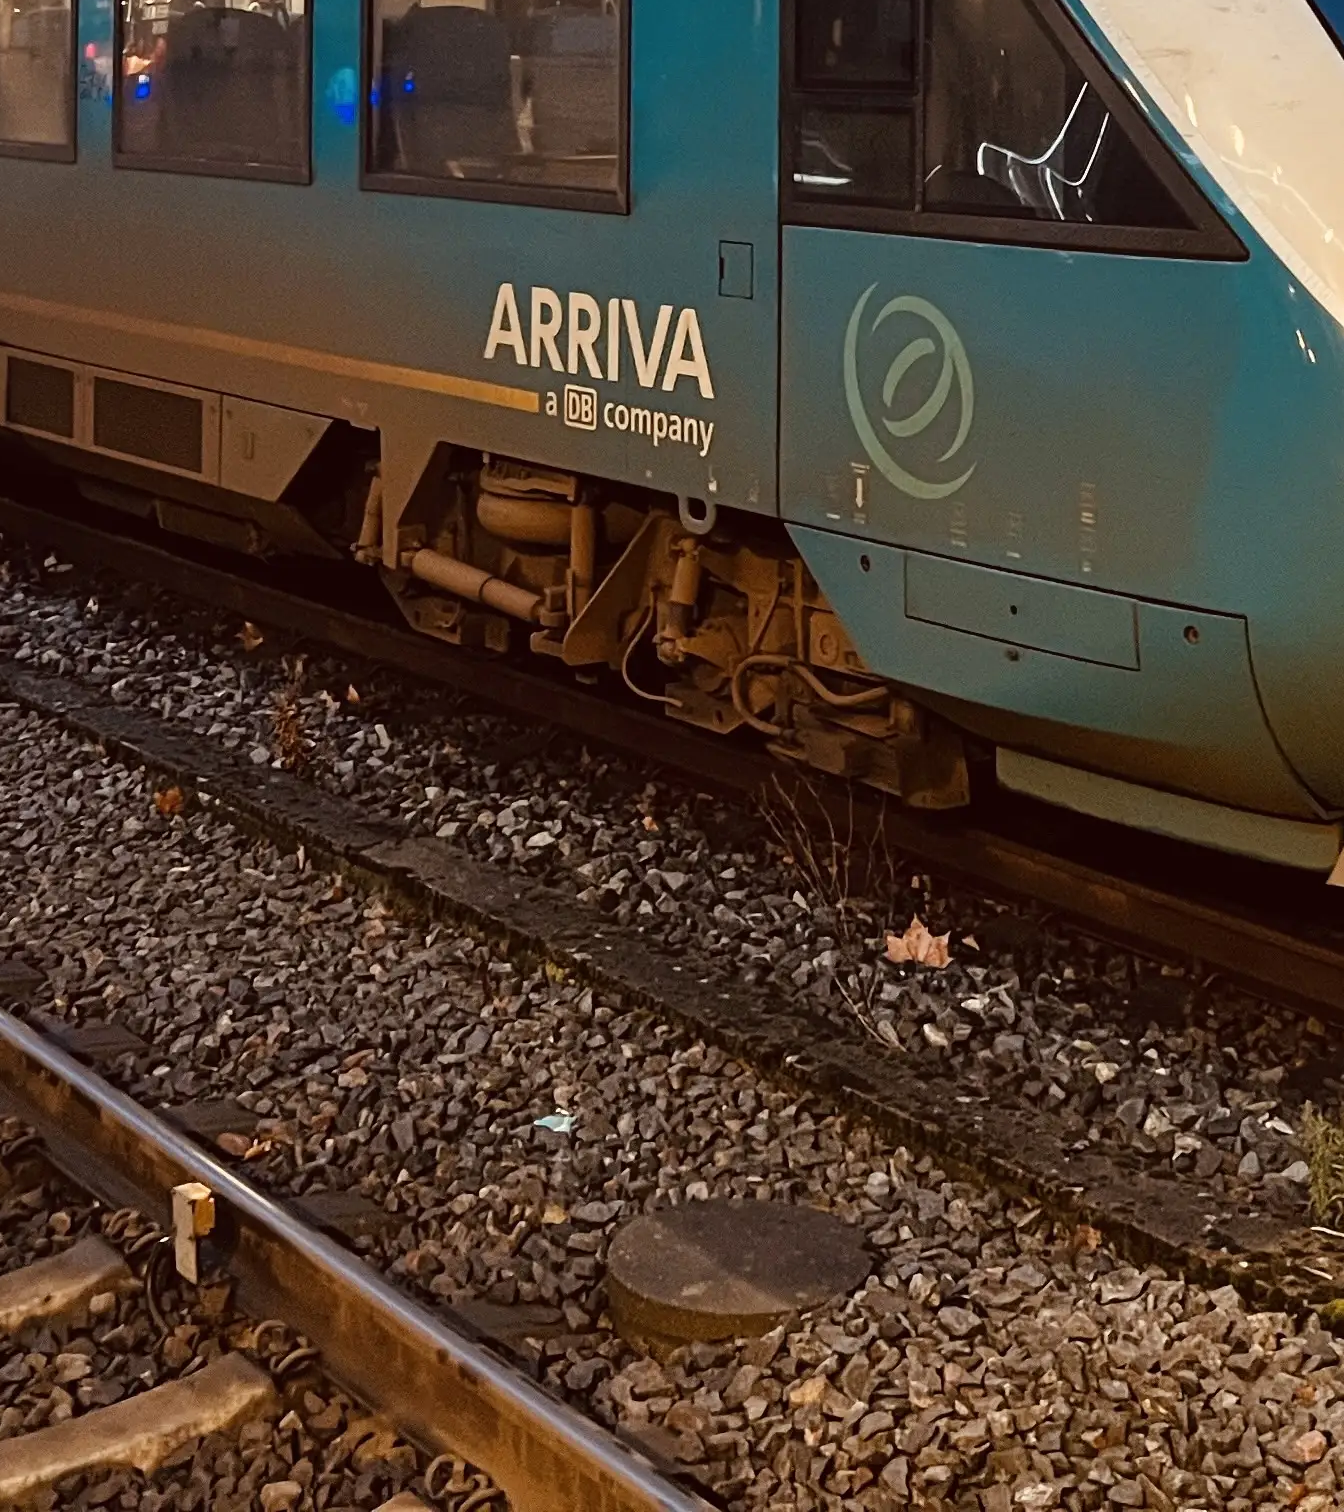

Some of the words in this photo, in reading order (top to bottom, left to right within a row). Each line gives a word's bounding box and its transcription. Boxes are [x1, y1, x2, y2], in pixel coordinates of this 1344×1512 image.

[483, 282, 715, 400] ARRIVA
[545, 390, 558, 417] a
[566, 389, 595, 426] DB
[603, 402, 715, 458] company
